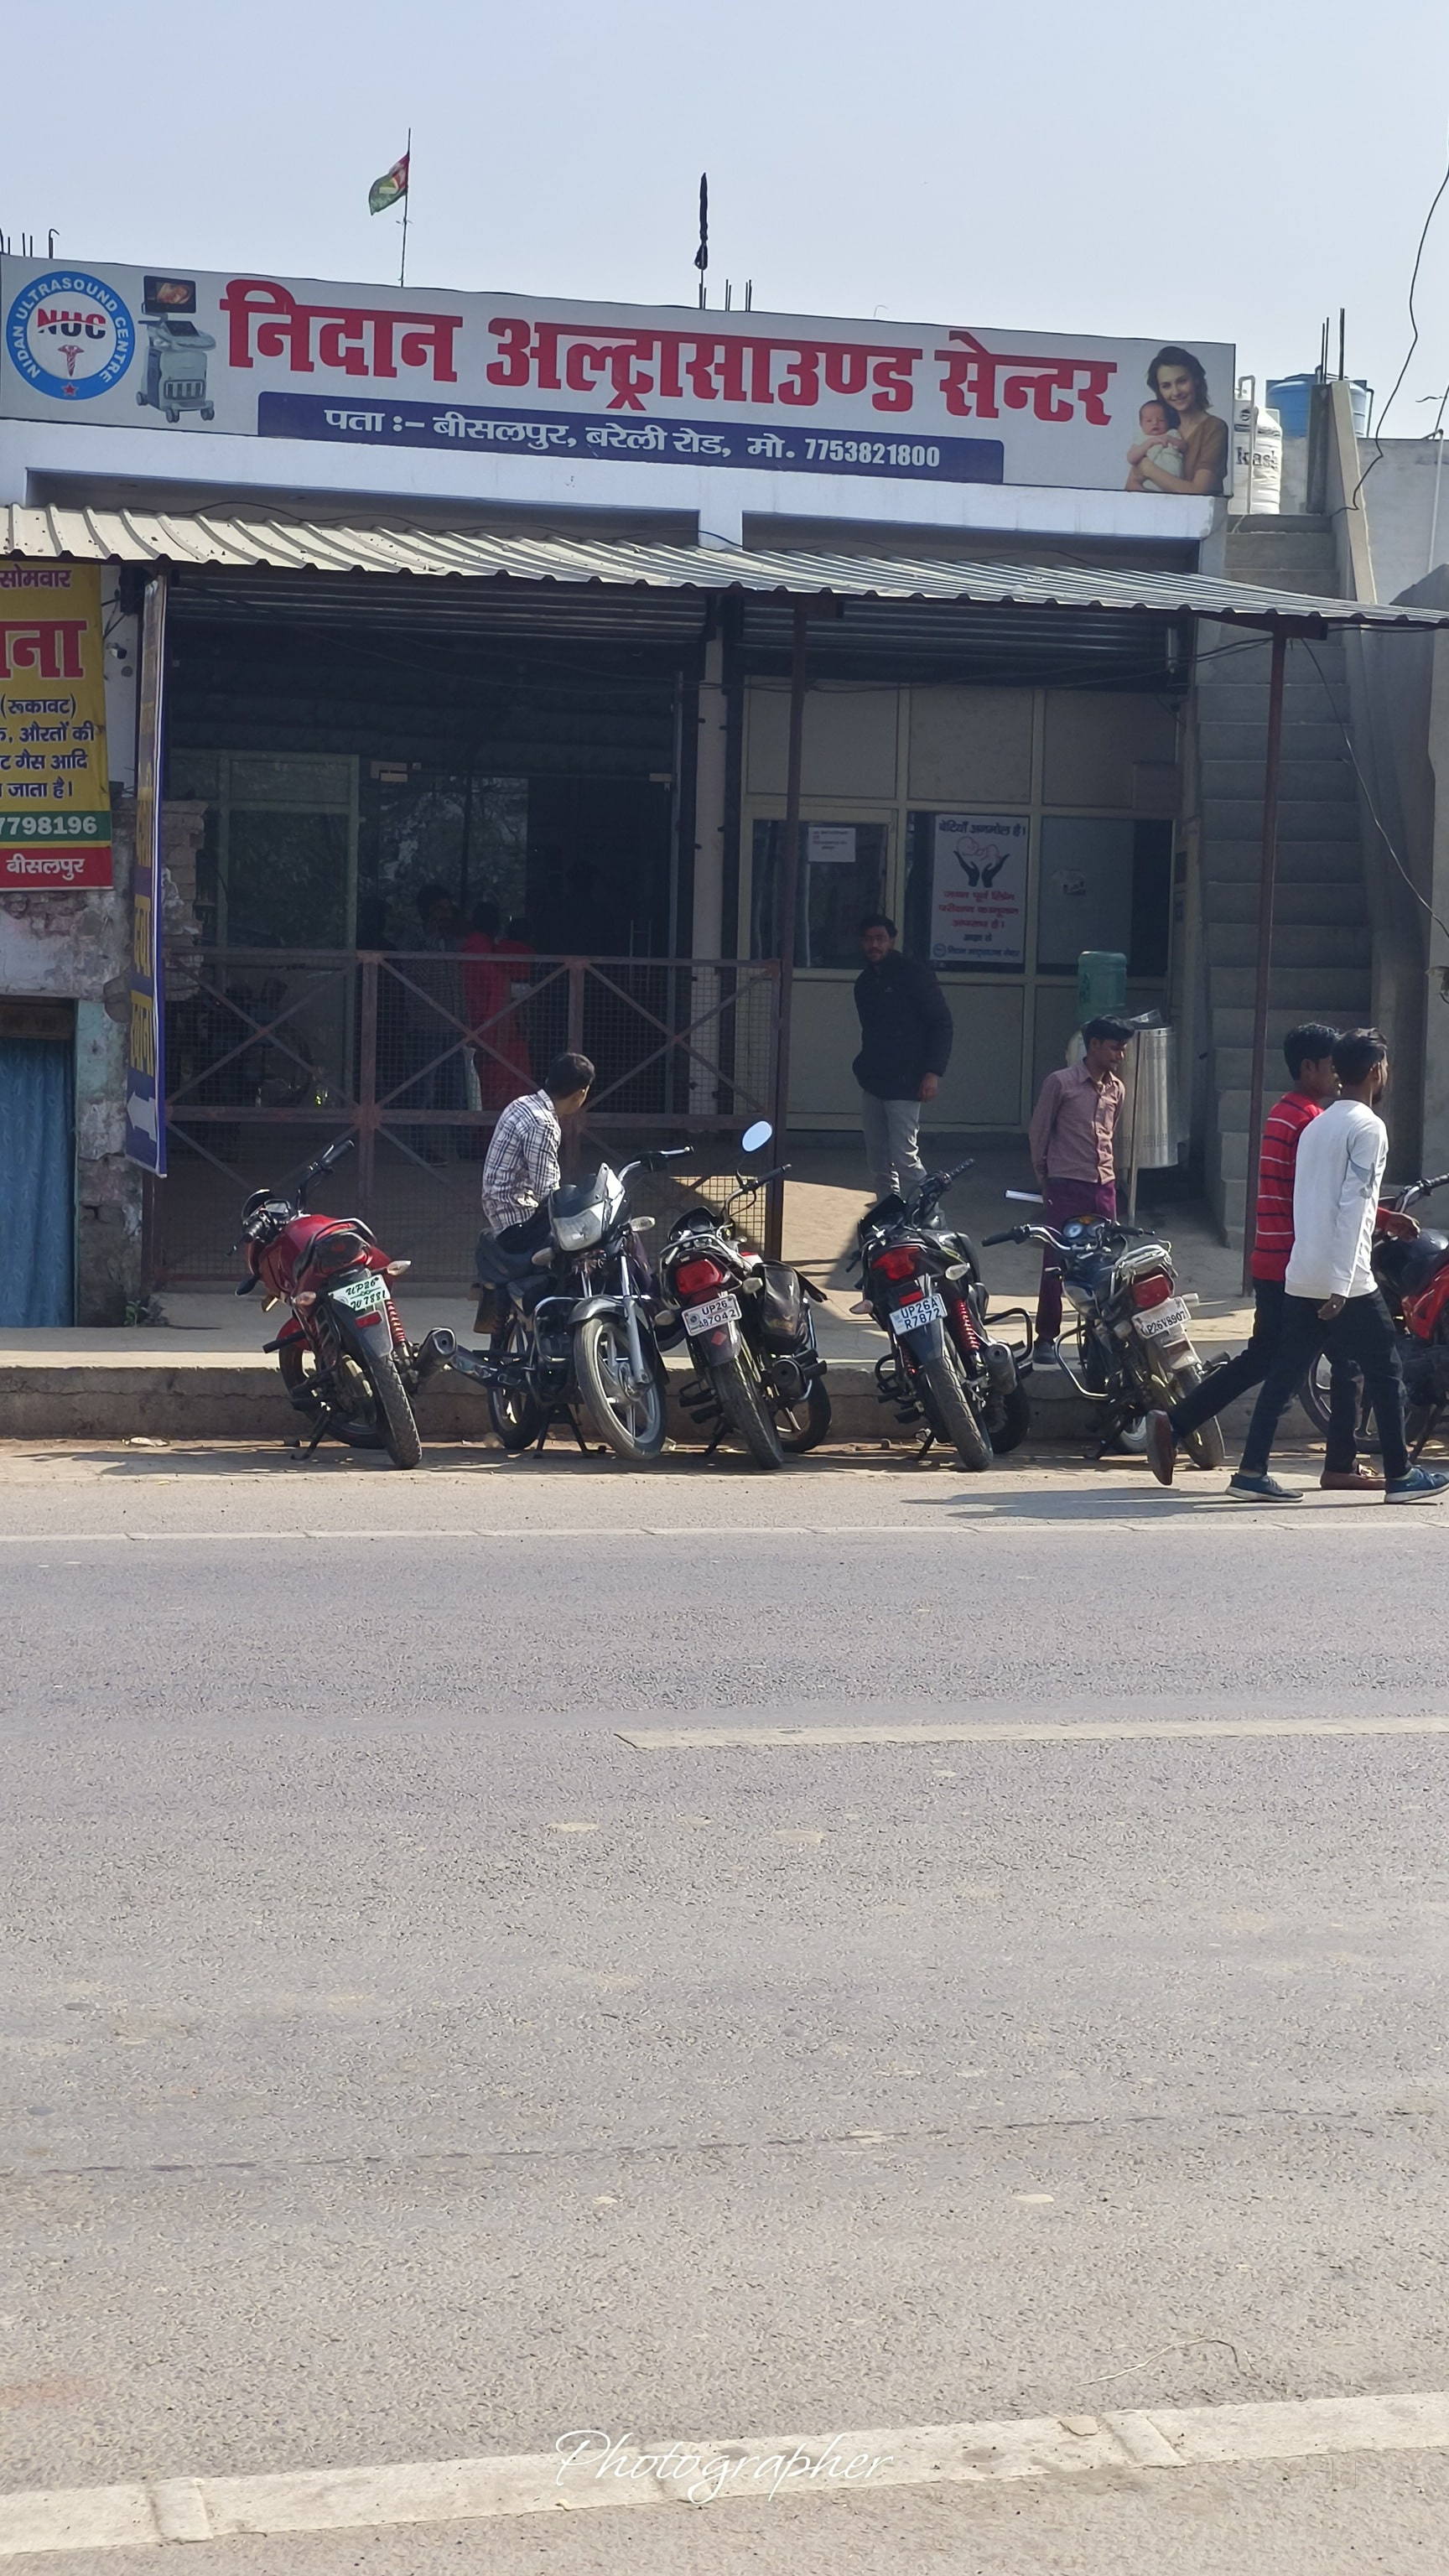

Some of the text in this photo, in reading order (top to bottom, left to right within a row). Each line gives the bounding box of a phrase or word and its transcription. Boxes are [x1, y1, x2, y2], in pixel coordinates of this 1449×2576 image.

[13, 278, 128, 383] NIDAN ULTRASOUND CENTRE
[37, 308, 106, 340] NUC
[219, 278, 1118, 426] निदान अल्ट्रासाउण्ड सेन्टर
[324, 408, 385, 432] पता
[432, 411, 577, 450] बीसलपुर,
[585, 423, 667, 451] बरेली
[672, 428, 732, 458] रोड,
[746, 433, 796, 459] मो.
[804, 438, 941, 468] 7753821800
[0, 563, 72, 588] सोमवार
[1, 692, 76, 719] (रूकावट)
[19, 719, 69, 742] औरतों
[72, 719, 95, 742] की
[15, 749, 45, 770] गैस
[50, 748, 88, 770] आदि
[7, 782, 48, 797] जाता
[53, 776, 73, 798] है।
[702, 1301, 728, 1316] UP26
[901, 1298, 938, 1319] UP26A
[904, 1308, 942, 1330] R7872
